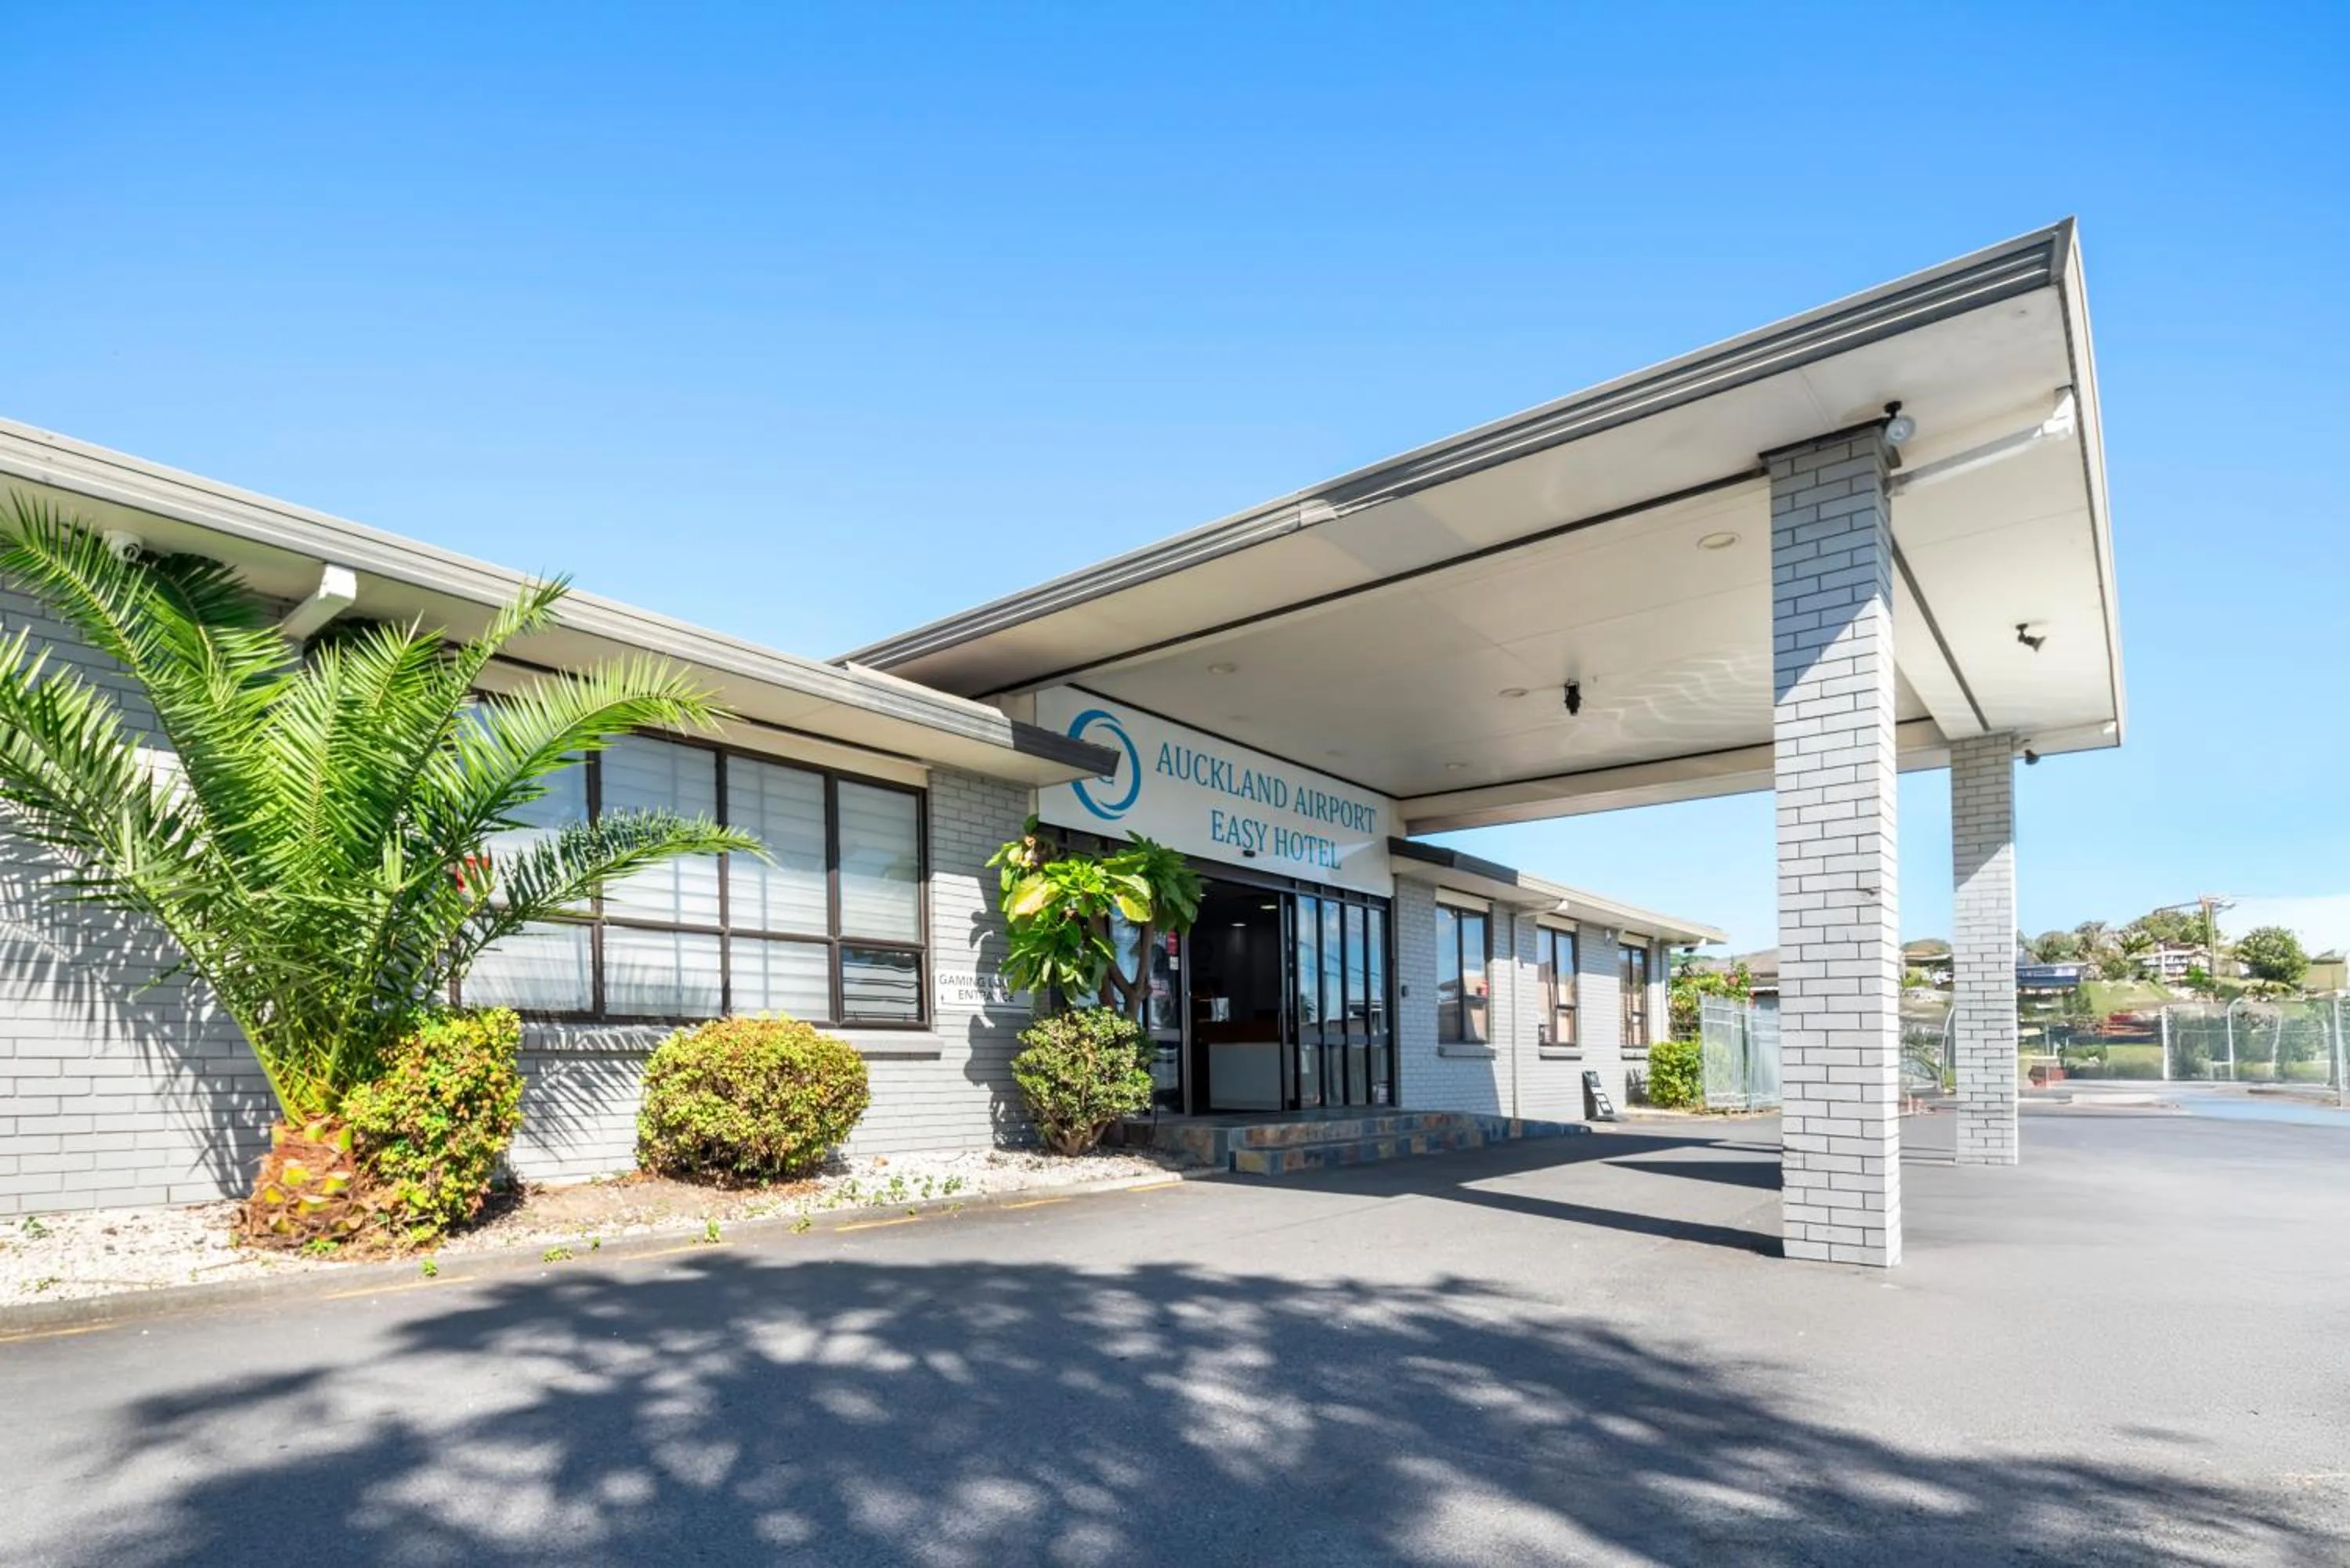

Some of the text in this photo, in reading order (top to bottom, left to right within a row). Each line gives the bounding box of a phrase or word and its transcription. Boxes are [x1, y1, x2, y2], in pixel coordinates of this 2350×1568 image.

[1155, 741, 1377, 834] AUCKLAND AIRPORT
[1211, 809, 1342, 871] EASY HOTEL
[940, 974, 985, 988] GAMING
